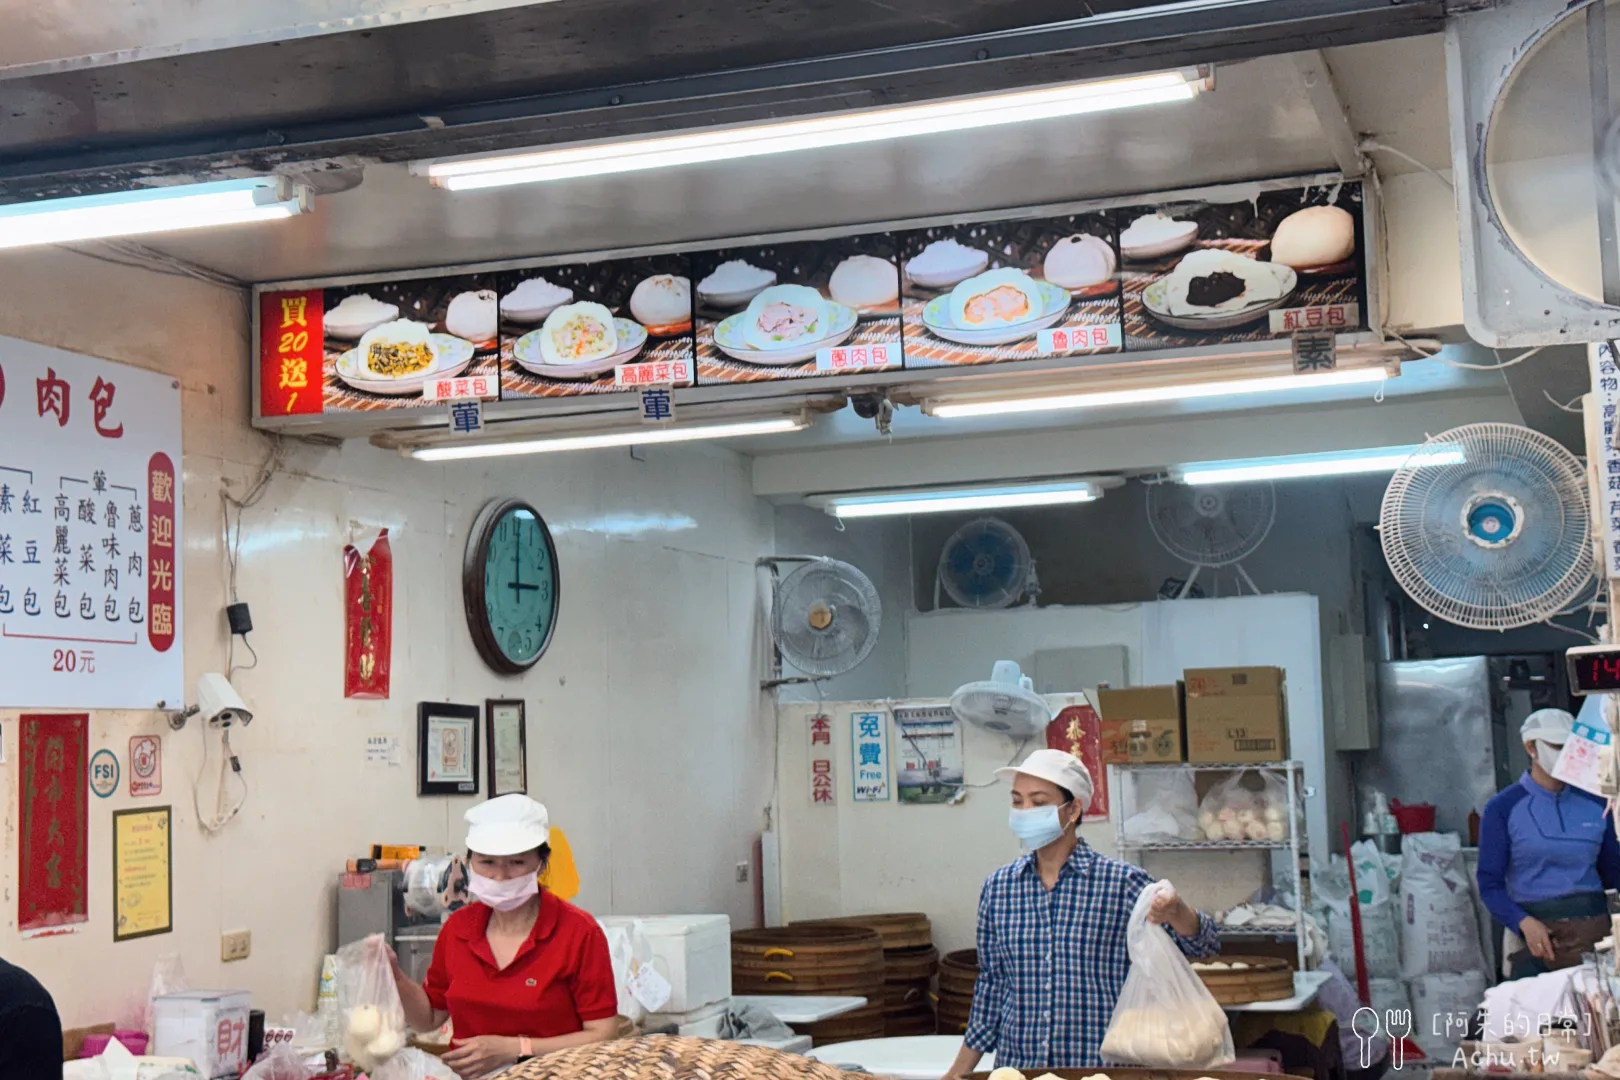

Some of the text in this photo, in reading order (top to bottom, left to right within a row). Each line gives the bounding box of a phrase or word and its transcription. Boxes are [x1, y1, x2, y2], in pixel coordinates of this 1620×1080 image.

[1283, 306, 1346, 329] 紅豆包
[1296, 336, 1332, 370] 素
[436, 378, 489, 398] 酸菜包
[621, 361, 688, 384] 高麗菜包
[451, 402, 481, 433] 葷
[642, 388, 672, 420] 葷
[92, 470, 107, 494] 葷
[22, 489, 42, 616] 紅豆包
[53, 493, 71, 618] 高麗菜包
[78, 498, 97, 620] 酸菜包
[102, 500, 121, 622] 魯味肉包
[152, 470, 173, 635] 歡迎光臨
[53, 650, 95, 673] 20元
[859, 716, 881, 765] 免費
[95, 764, 114, 779] FSI
[860, 769, 882, 780] Free
